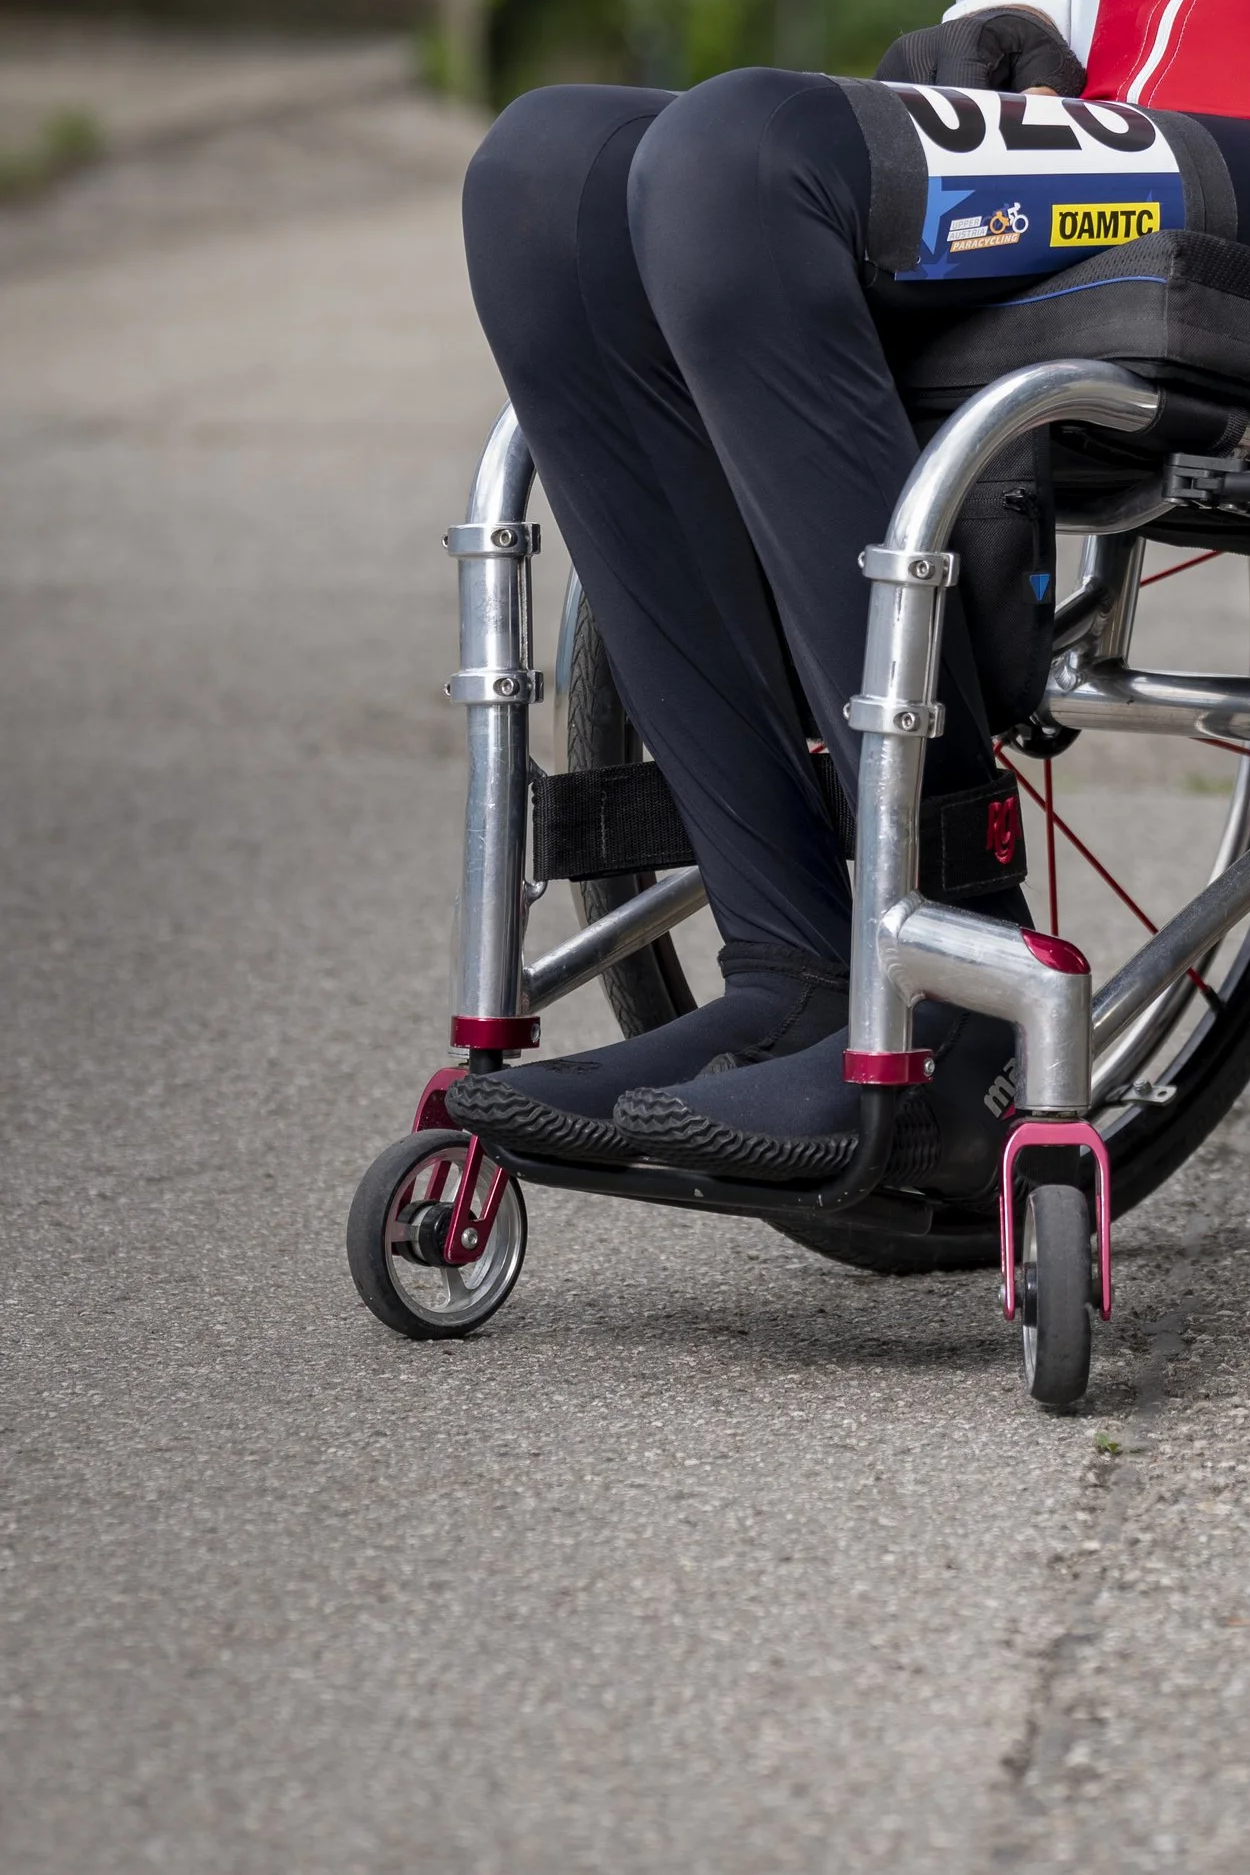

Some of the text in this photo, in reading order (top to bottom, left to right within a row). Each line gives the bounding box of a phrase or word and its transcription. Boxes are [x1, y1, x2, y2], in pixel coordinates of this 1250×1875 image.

[952, 218, 980, 230] UPPER
[1058, 209, 1154, 240] ÖAMTC
[949, 228, 986, 240] AUSTRIA
[952, 233, 1019, 251] PARACYCLING
